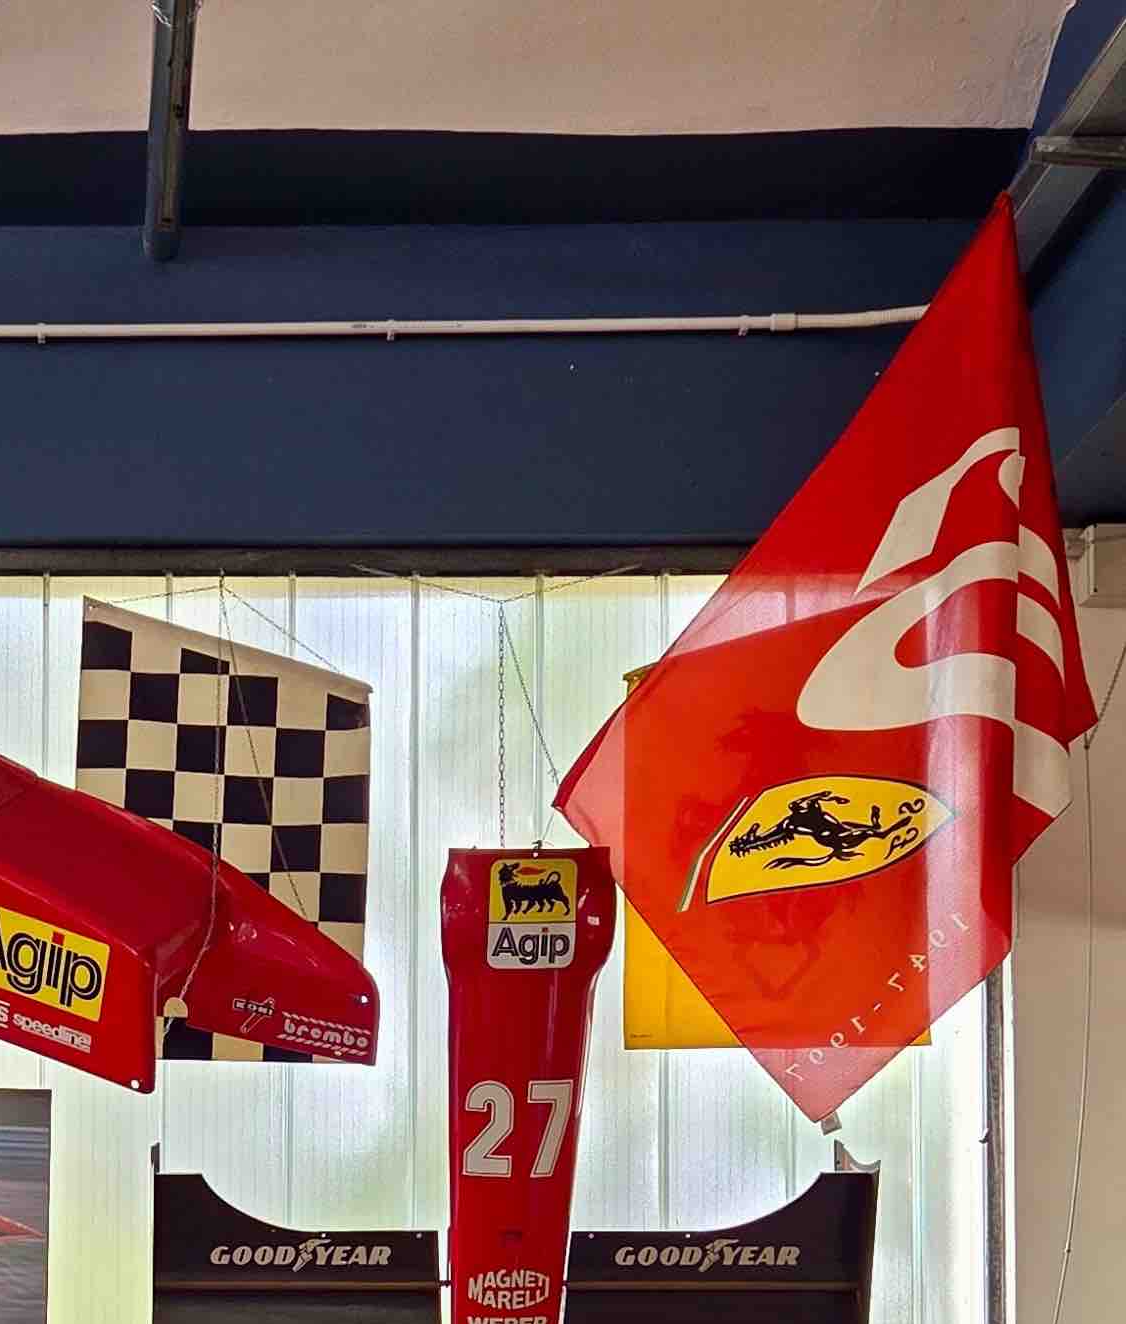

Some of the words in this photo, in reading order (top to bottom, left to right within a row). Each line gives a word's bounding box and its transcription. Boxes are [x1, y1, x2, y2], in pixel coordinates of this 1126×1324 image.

[491, 926, 570, 966] Agip
[236, 1000, 273, 1016] KONI
[12, 1012, 92, 1054] speedline
[283, 1018, 369, 1048] brembo
[462, 1079, 574, 1178] 27
[467, 1269, 550, 1291] MAGNETI
